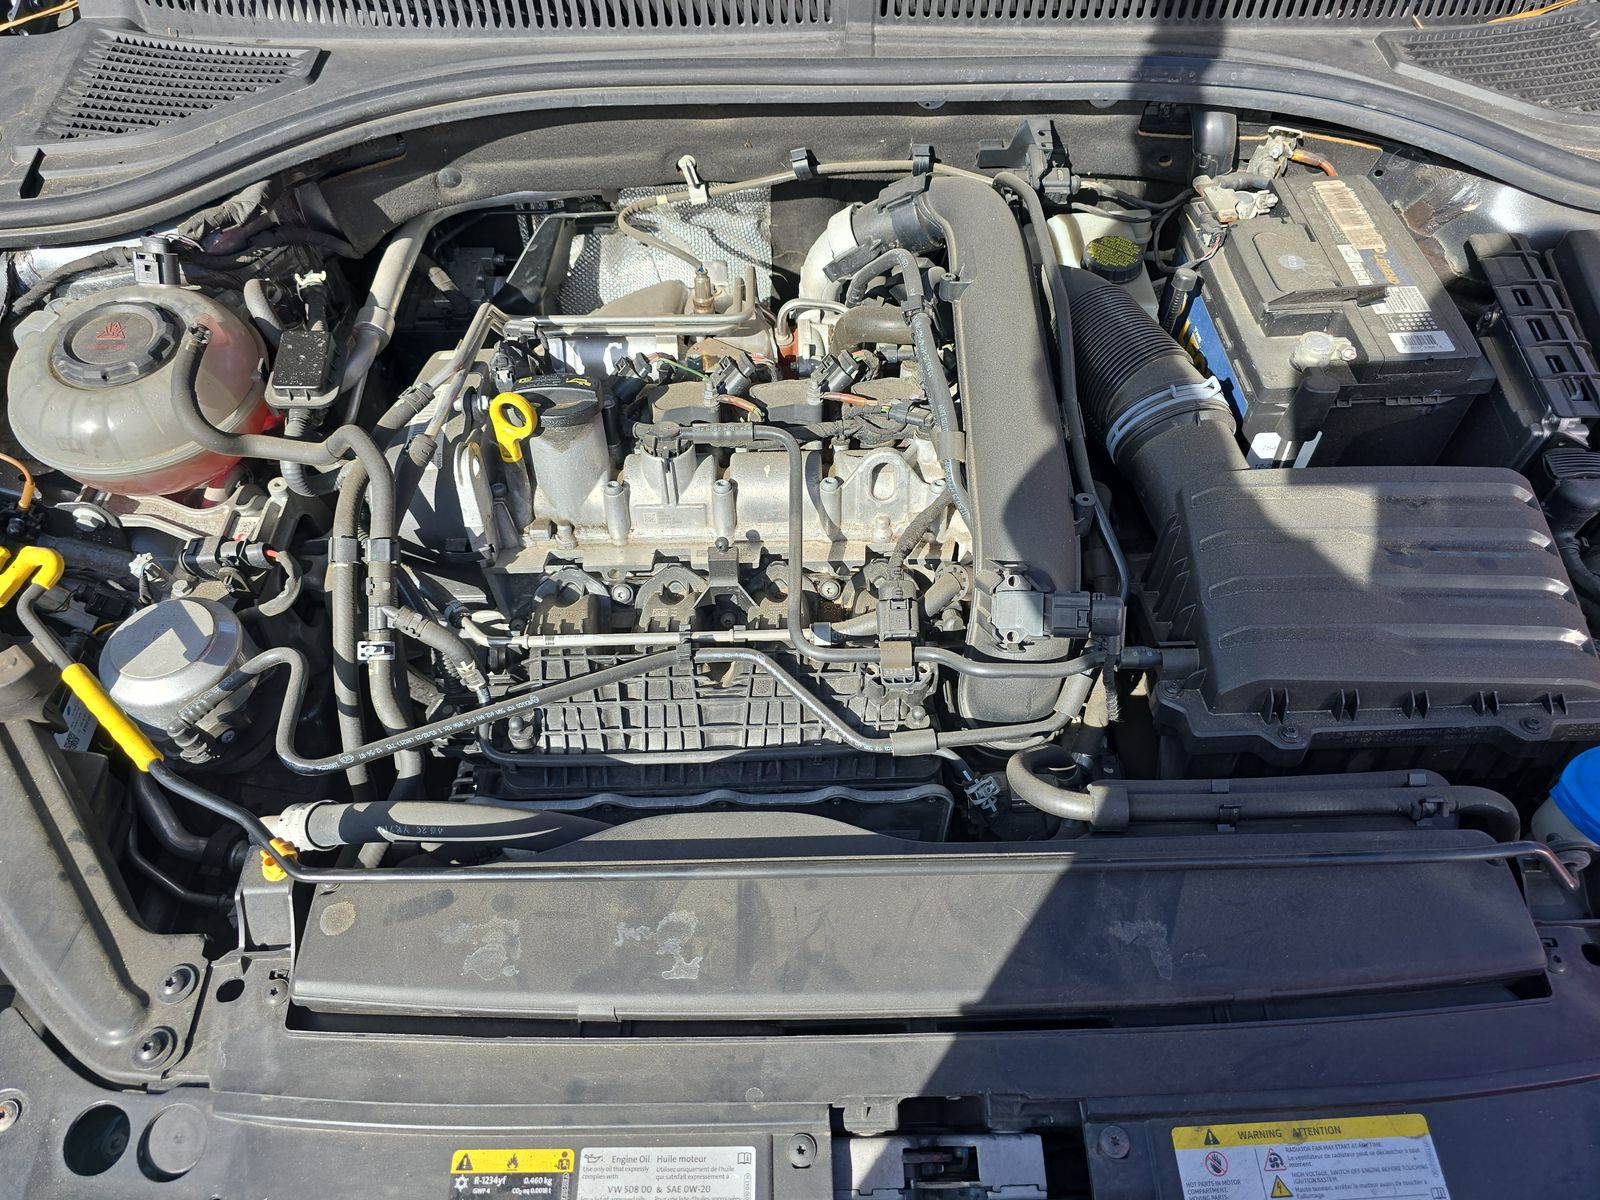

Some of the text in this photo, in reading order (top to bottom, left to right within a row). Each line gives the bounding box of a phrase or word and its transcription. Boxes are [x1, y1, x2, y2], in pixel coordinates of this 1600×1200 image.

[1238, 1129, 1282, 1140] WARNING
[1292, 1125, 1342, 1138] ATTENTION
[612, 1155, 651, 1165] Engine Oil
[656, 1155, 677, 1163] Huile
[474, 1175, 553, 1187] R-1234yf 0.460 kg
[608, 1185, 622, 1193] VW
[624, 1185, 639, 1193] 508
[641, 1185, 653, 1193] 00
[666, 1185, 681, 1193] SAE
[683, 1185, 711, 1193] 0W-20
